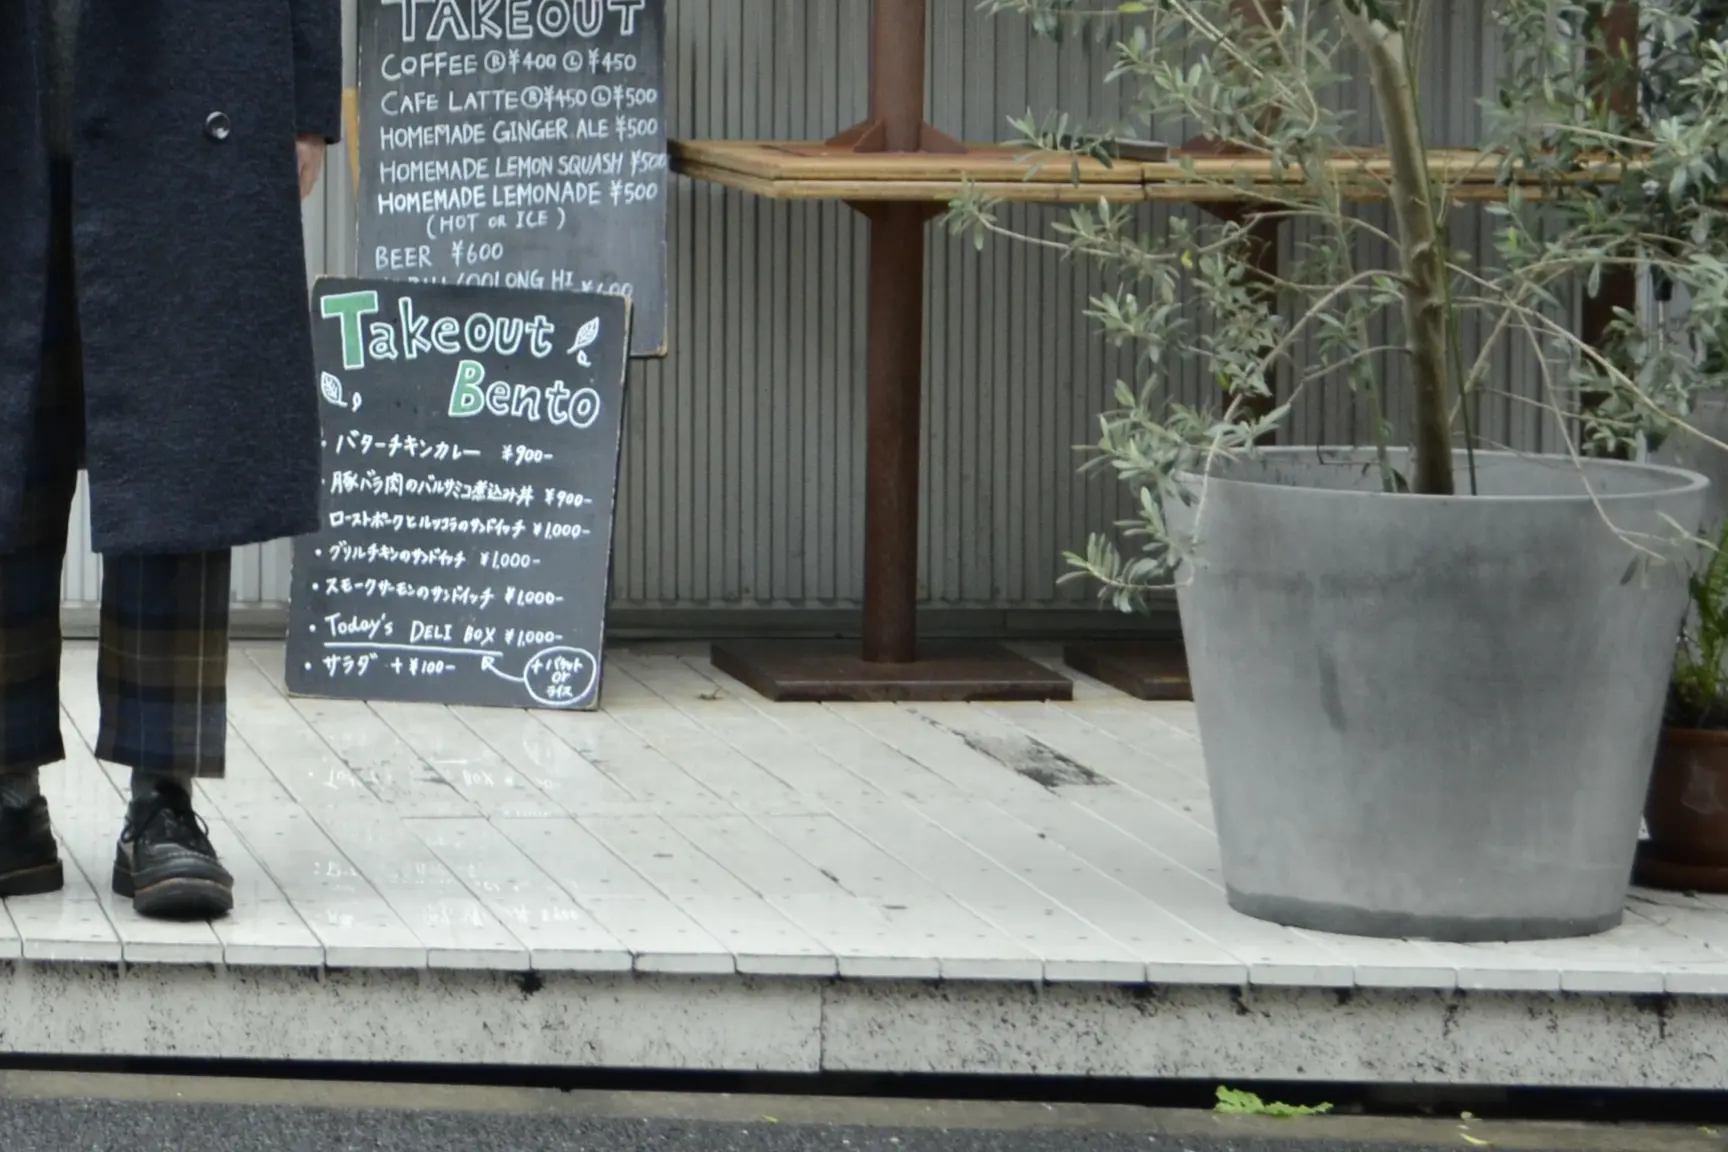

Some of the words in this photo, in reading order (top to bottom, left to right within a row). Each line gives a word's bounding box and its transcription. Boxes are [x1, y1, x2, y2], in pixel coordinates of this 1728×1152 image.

[381, 51, 477, 81] COFFEE
[381, 91, 438, 116] CAFE
[449, 89, 519, 112] LATTE
[380, 122, 486, 150] HOMEMADE
[492, 116, 569, 143] GINGER
[576, 117, 609, 138] ALE
[615, 116, 659, 142] ¥500
[380, 156, 490, 184] HOMEMADE
[495, 153, 554, 179] LEMON
[556, 151, 624, 175] SQUASH
[378, 185, 486, 215] HOMEMADE
[492, 180, 602, 208] LEMONADE
[610, 179, 658, 207] ¥500
[375, 244, 433, 270] BEER
[452, 240, 504, 267] ¥600
[321, 290, 555, 369] Takeout
[448, 359, 601, 428] Bento
[324, 612, 394, 637] Today's
[410, 619, 452, 643] DELI
[463, 625, 496, 646] BOX
[322, 652, 379, 677] サラダ
